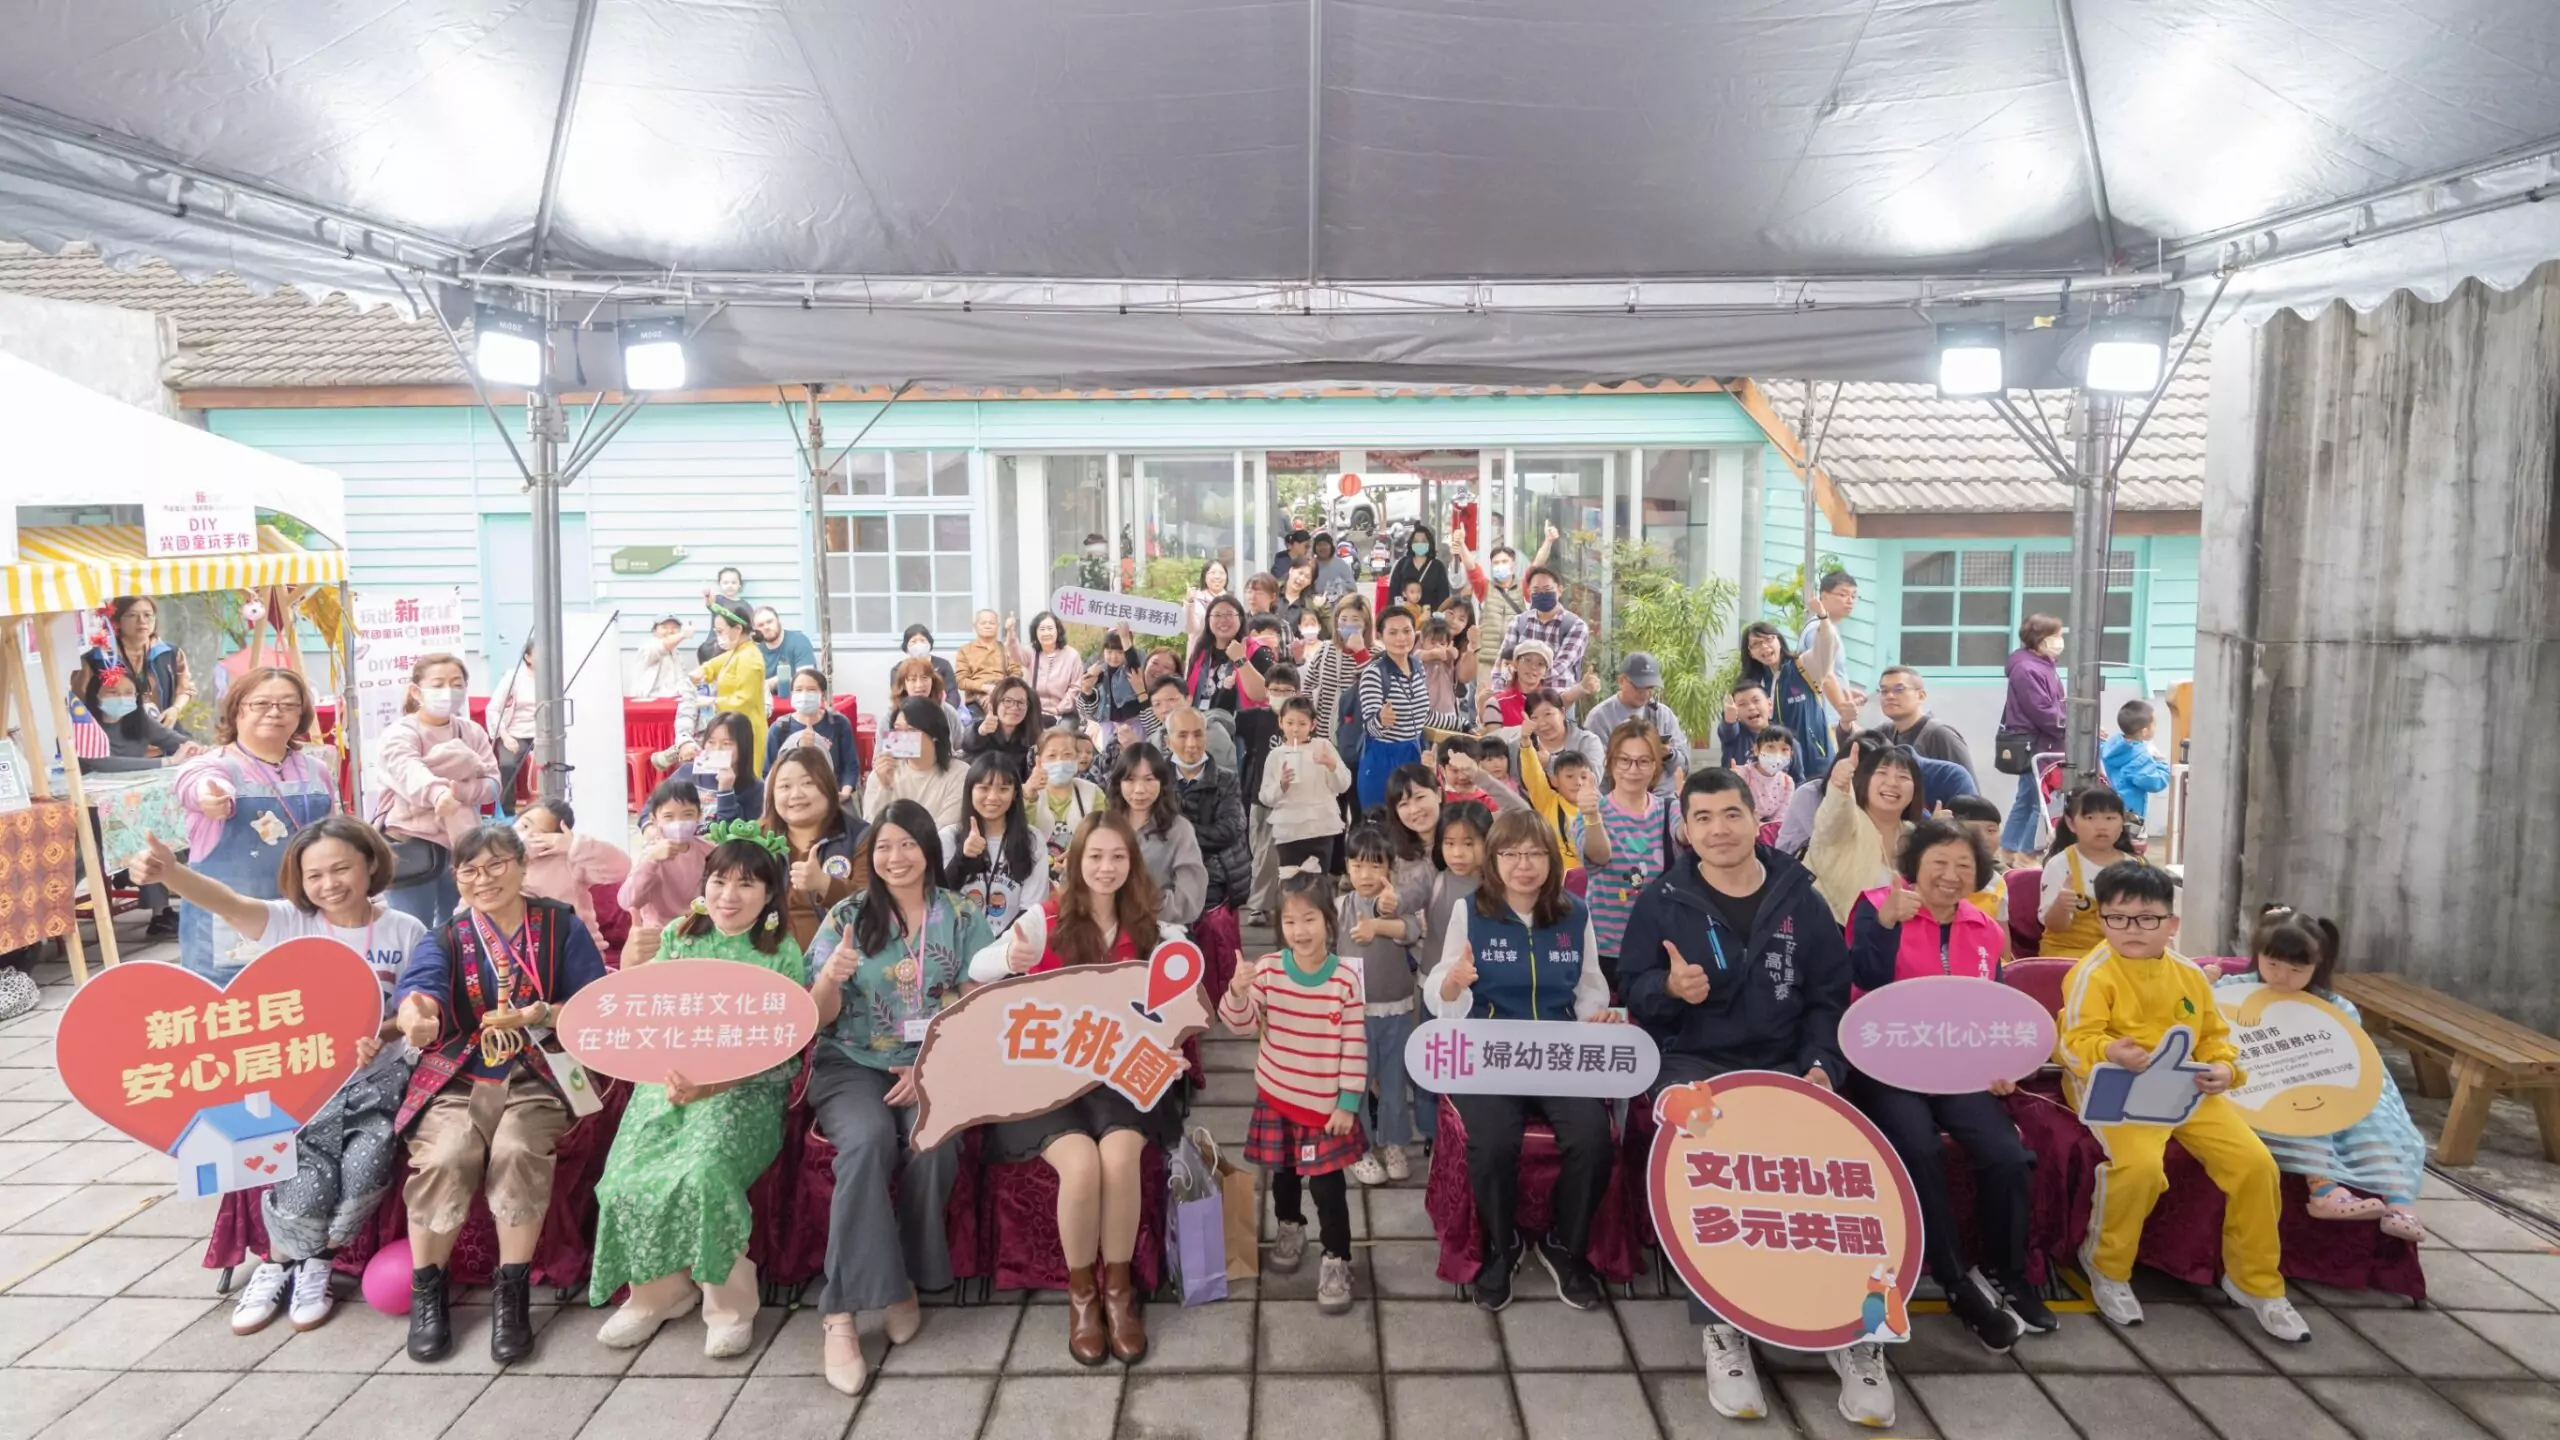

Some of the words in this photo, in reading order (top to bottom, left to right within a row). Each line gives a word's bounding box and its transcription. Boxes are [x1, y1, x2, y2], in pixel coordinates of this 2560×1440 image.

[189, 518, 218, 532] DIY
[1088, 599, 1178, 627] 新住民事務科
[366, 949, 403, 965] AND
[145, 989, 304, 1049] 新住民
[596, 991, 787, 1018] 多元族群文化與
[577, 1022, 798, 1051] 在地文化共融共好
[1859, 1020, 2038, 1049] 多元文化心共榮
[2239, 1026, 2281, 1045] 桃園市
[2239, 1029, 2332, 1061] 民家庭服務中心
[122, 1033, 336, 1106] 安心居桃
[1004, 1002, 1180, 1107] 在桃園
[1482, 1040, 1637, 1074] 婦幼發展局
[1686, 1151, 1876, 1200] 文化扎根
[1692, 1206, 1887, 1255] 多元共融
